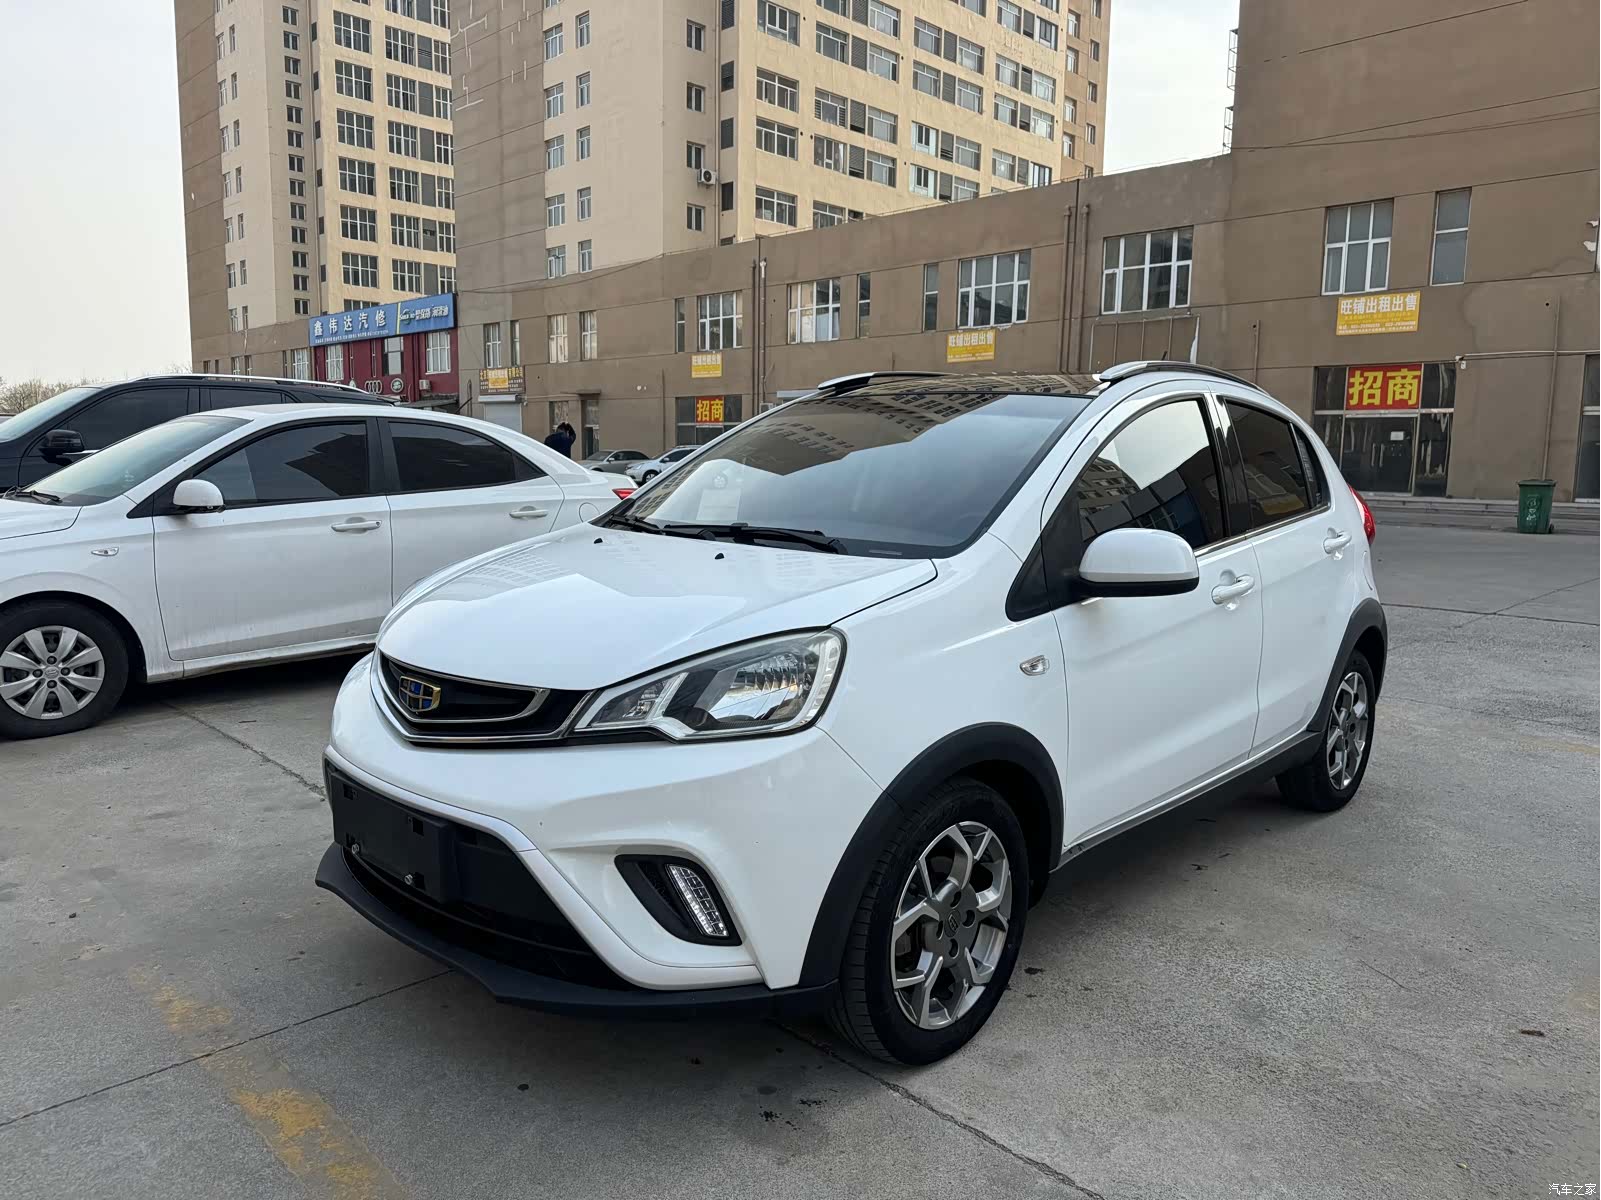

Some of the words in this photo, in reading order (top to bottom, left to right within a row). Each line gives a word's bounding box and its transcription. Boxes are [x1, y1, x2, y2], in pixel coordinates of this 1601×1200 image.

[1341, 293, 1417, 315] 旺铺出租出售
[314, 310, 386, 336] 鑫伟达汽修
[948, 330, 993, 347] 旺铺出租出售
[1348, 368, 1421, 406] 招商
[697, 399, 724, 421] 招商
